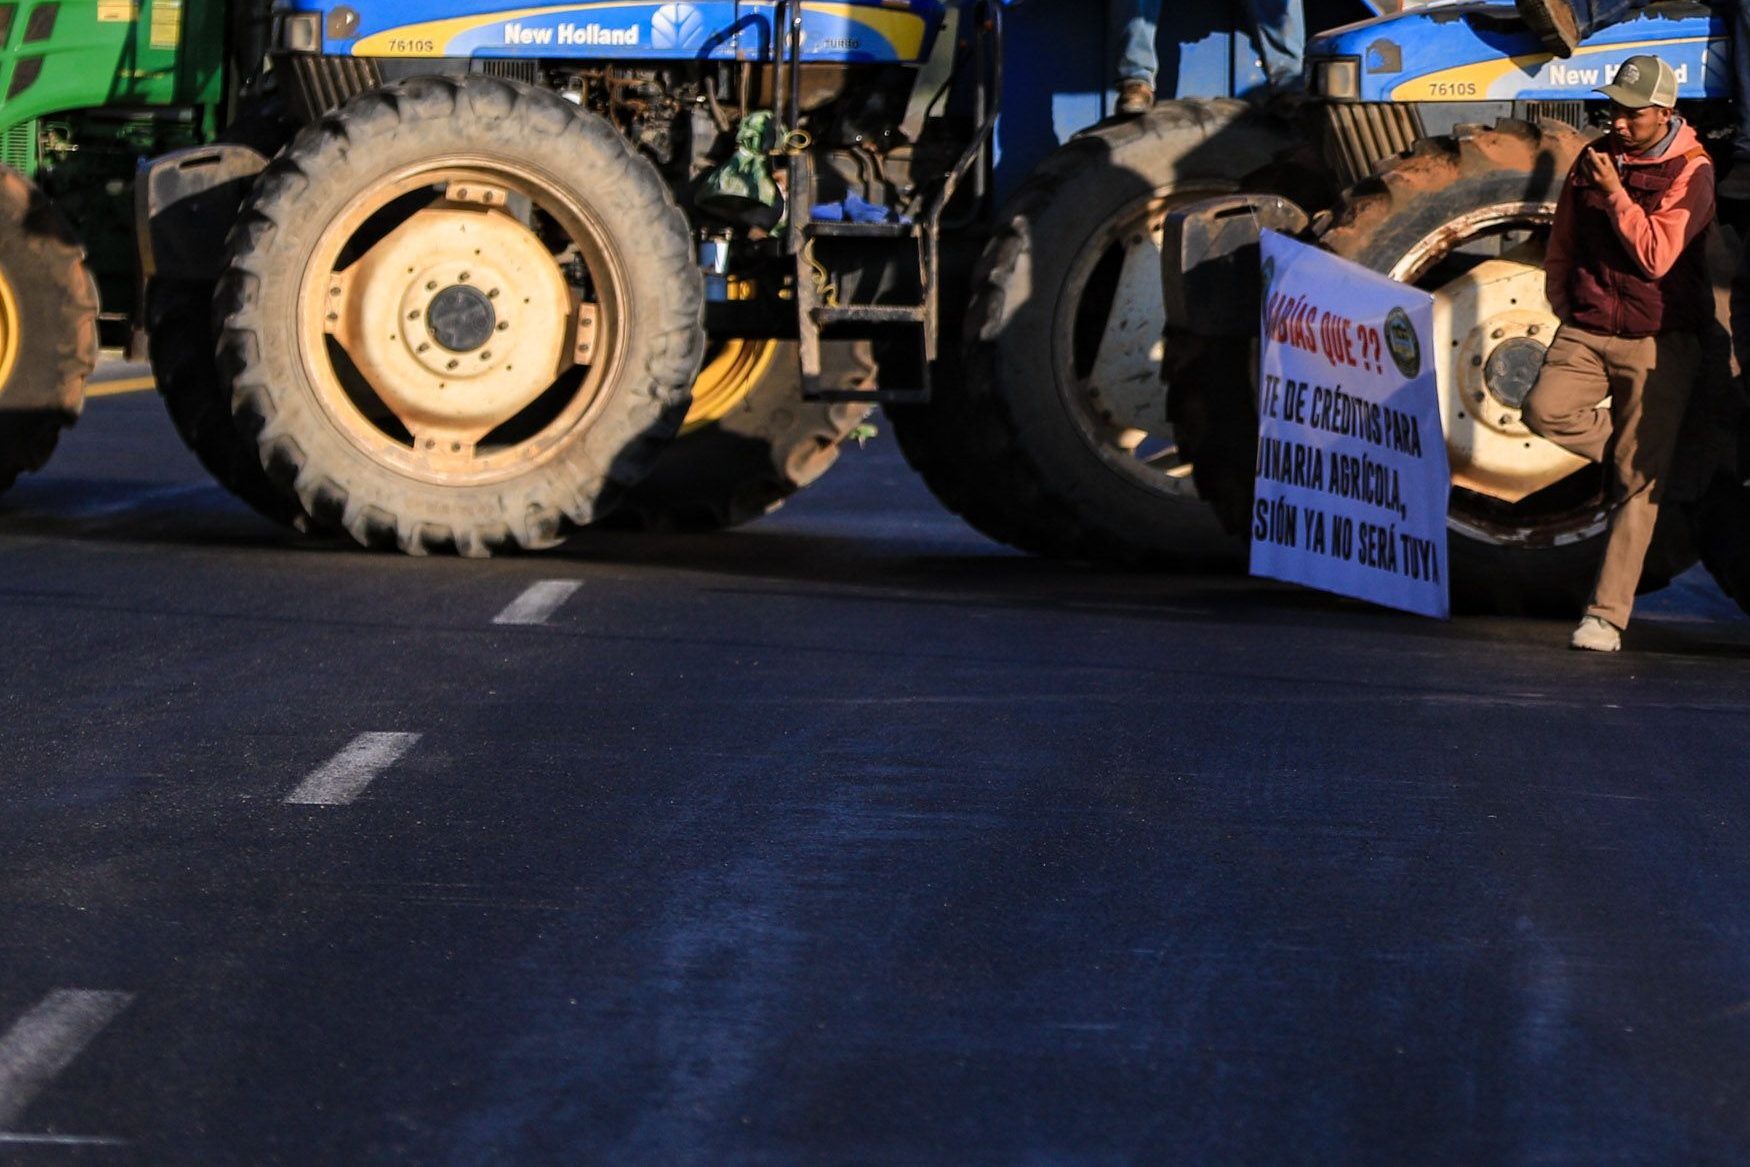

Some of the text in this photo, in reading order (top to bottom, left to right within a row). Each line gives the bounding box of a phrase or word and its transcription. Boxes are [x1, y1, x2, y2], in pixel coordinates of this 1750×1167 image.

[504, 24, 639, 46] New Holland
[388, 40, 434, 53] 7610S
[1550, 64, 1599, 85] New
[1429, 83, 1476, 96] 7610S
[1320, 311, 1357, 368] QUE
[1284, 379, 1308, 425] DE
[1310, 385, 1382, 446] CRÉDITOS
[1384, 405, 1422, 459] PARA
[1304, 508, 1326, 555] YA
[1332, 514, 1353, 562] NO
[1358, 521, 1397, 573] SERÁ
